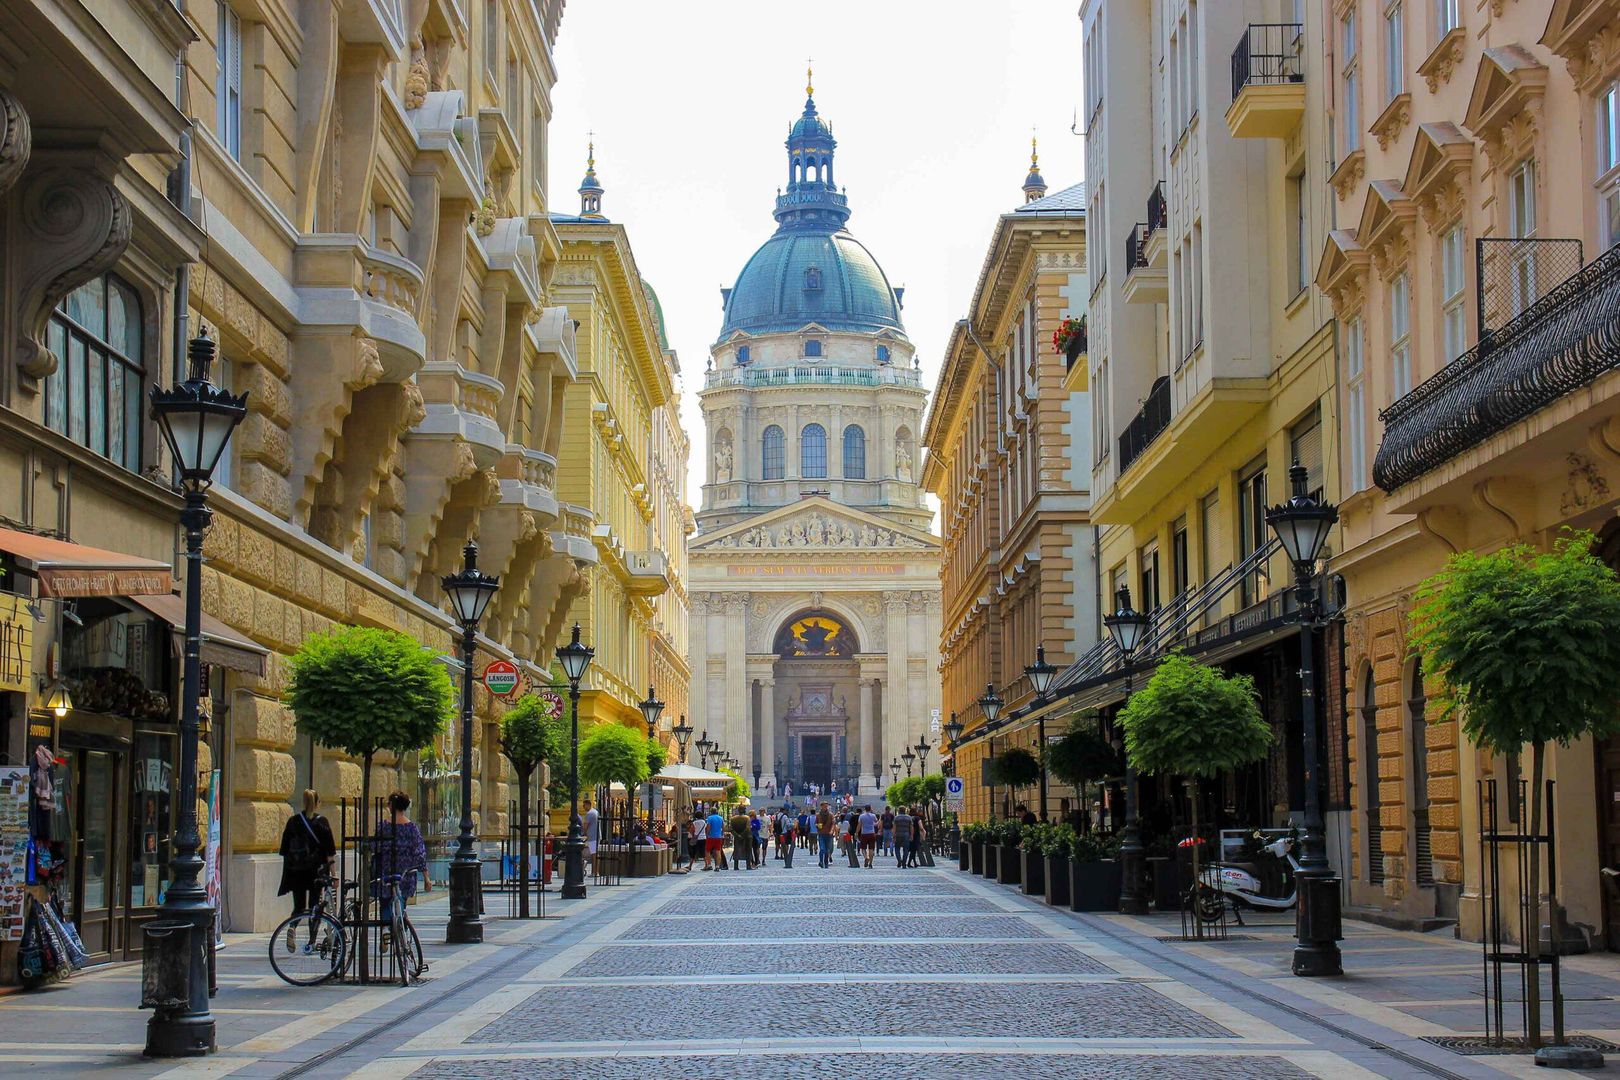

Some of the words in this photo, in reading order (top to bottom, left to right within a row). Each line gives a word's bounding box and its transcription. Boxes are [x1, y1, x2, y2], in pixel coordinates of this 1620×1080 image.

[737, 566, 756, 575] EGO
[763, 566, 784, 575] SUM
[791, 566, 808, 575] VIA
[812, 566, 851, 575] VERITAS
[874, 566, 895, 575] VITA
